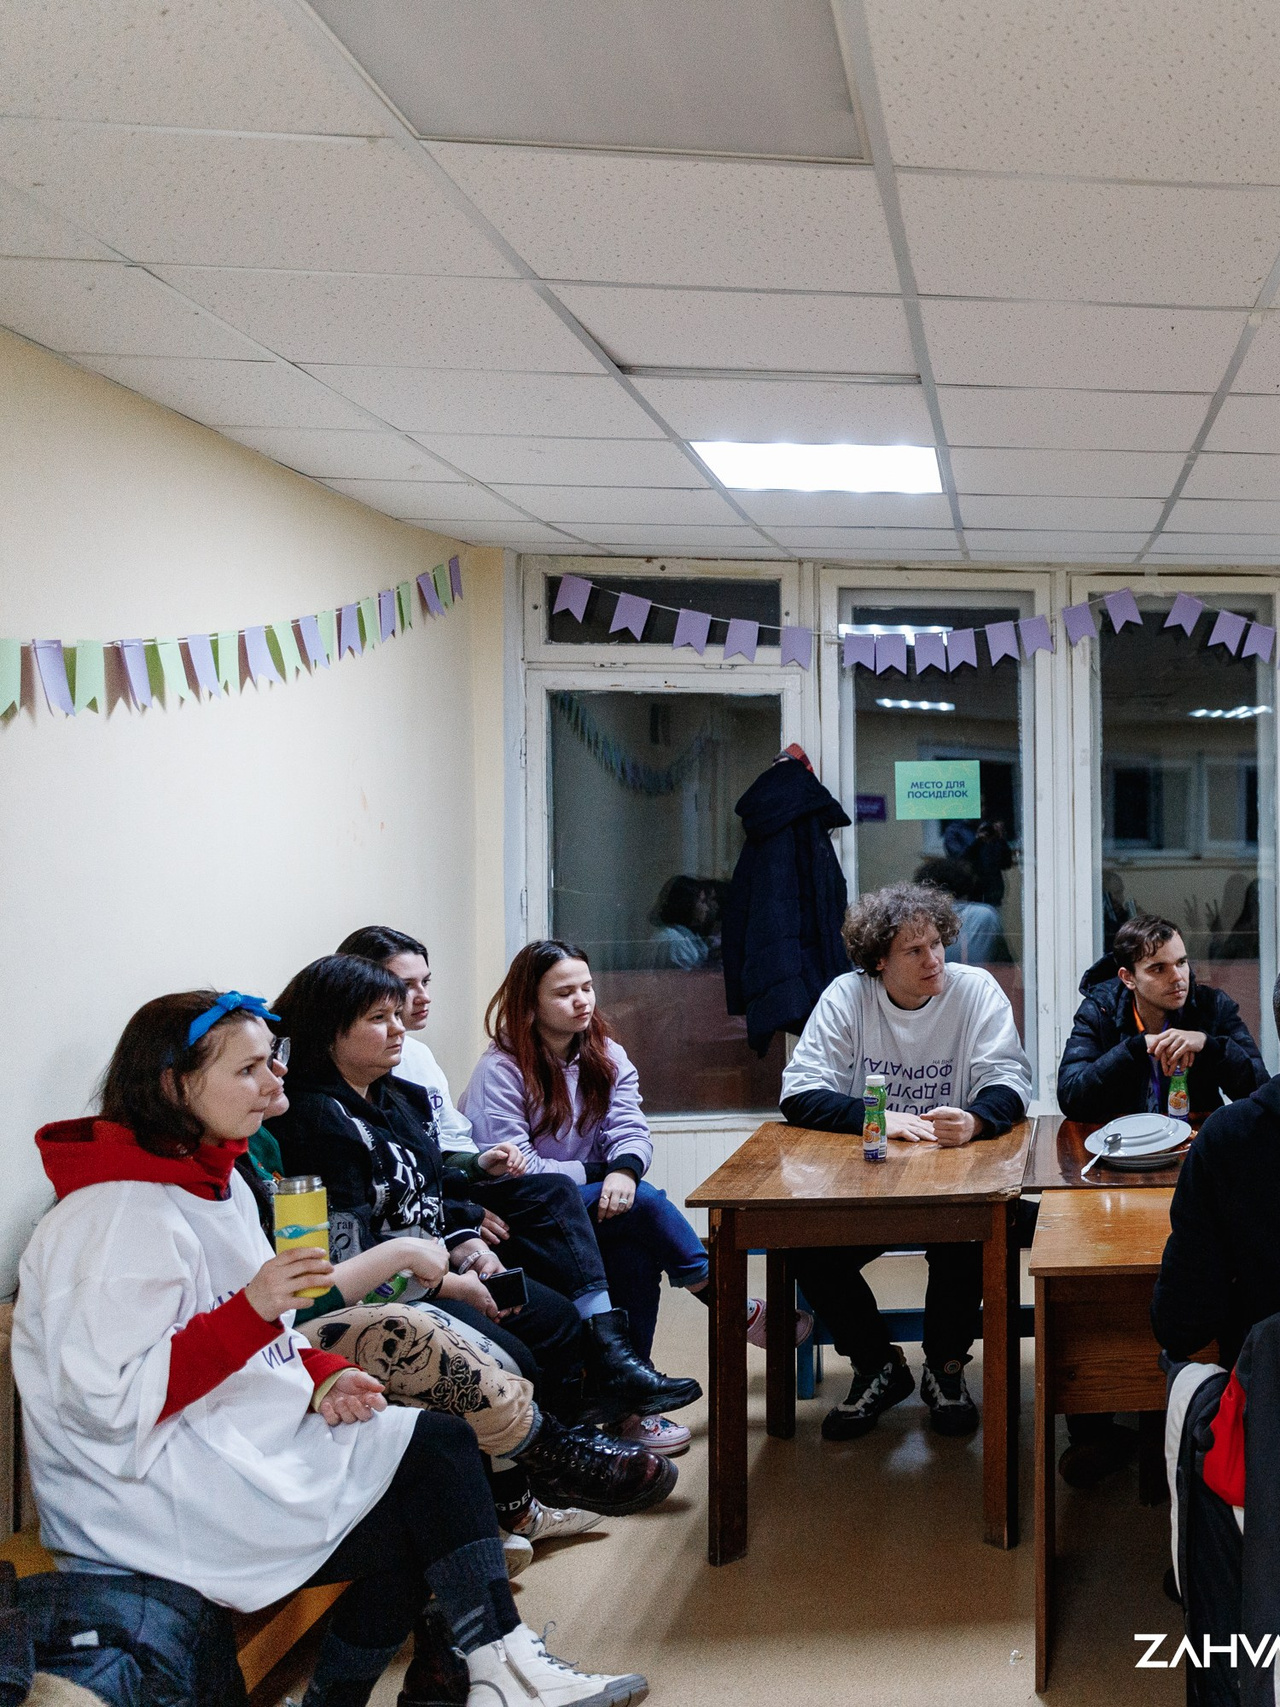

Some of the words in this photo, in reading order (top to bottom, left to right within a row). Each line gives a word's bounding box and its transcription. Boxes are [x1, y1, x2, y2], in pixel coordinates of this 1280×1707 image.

[910, 781, 943, 789] МЕСТО
[945, 780, 965, 789] ДЛЯ
[907, 790, 968, 799] ПОСИДЕЛОК
[885, 1082, 938, 1099] ДРУГИ
[940, 1082, 951, 1096] В
